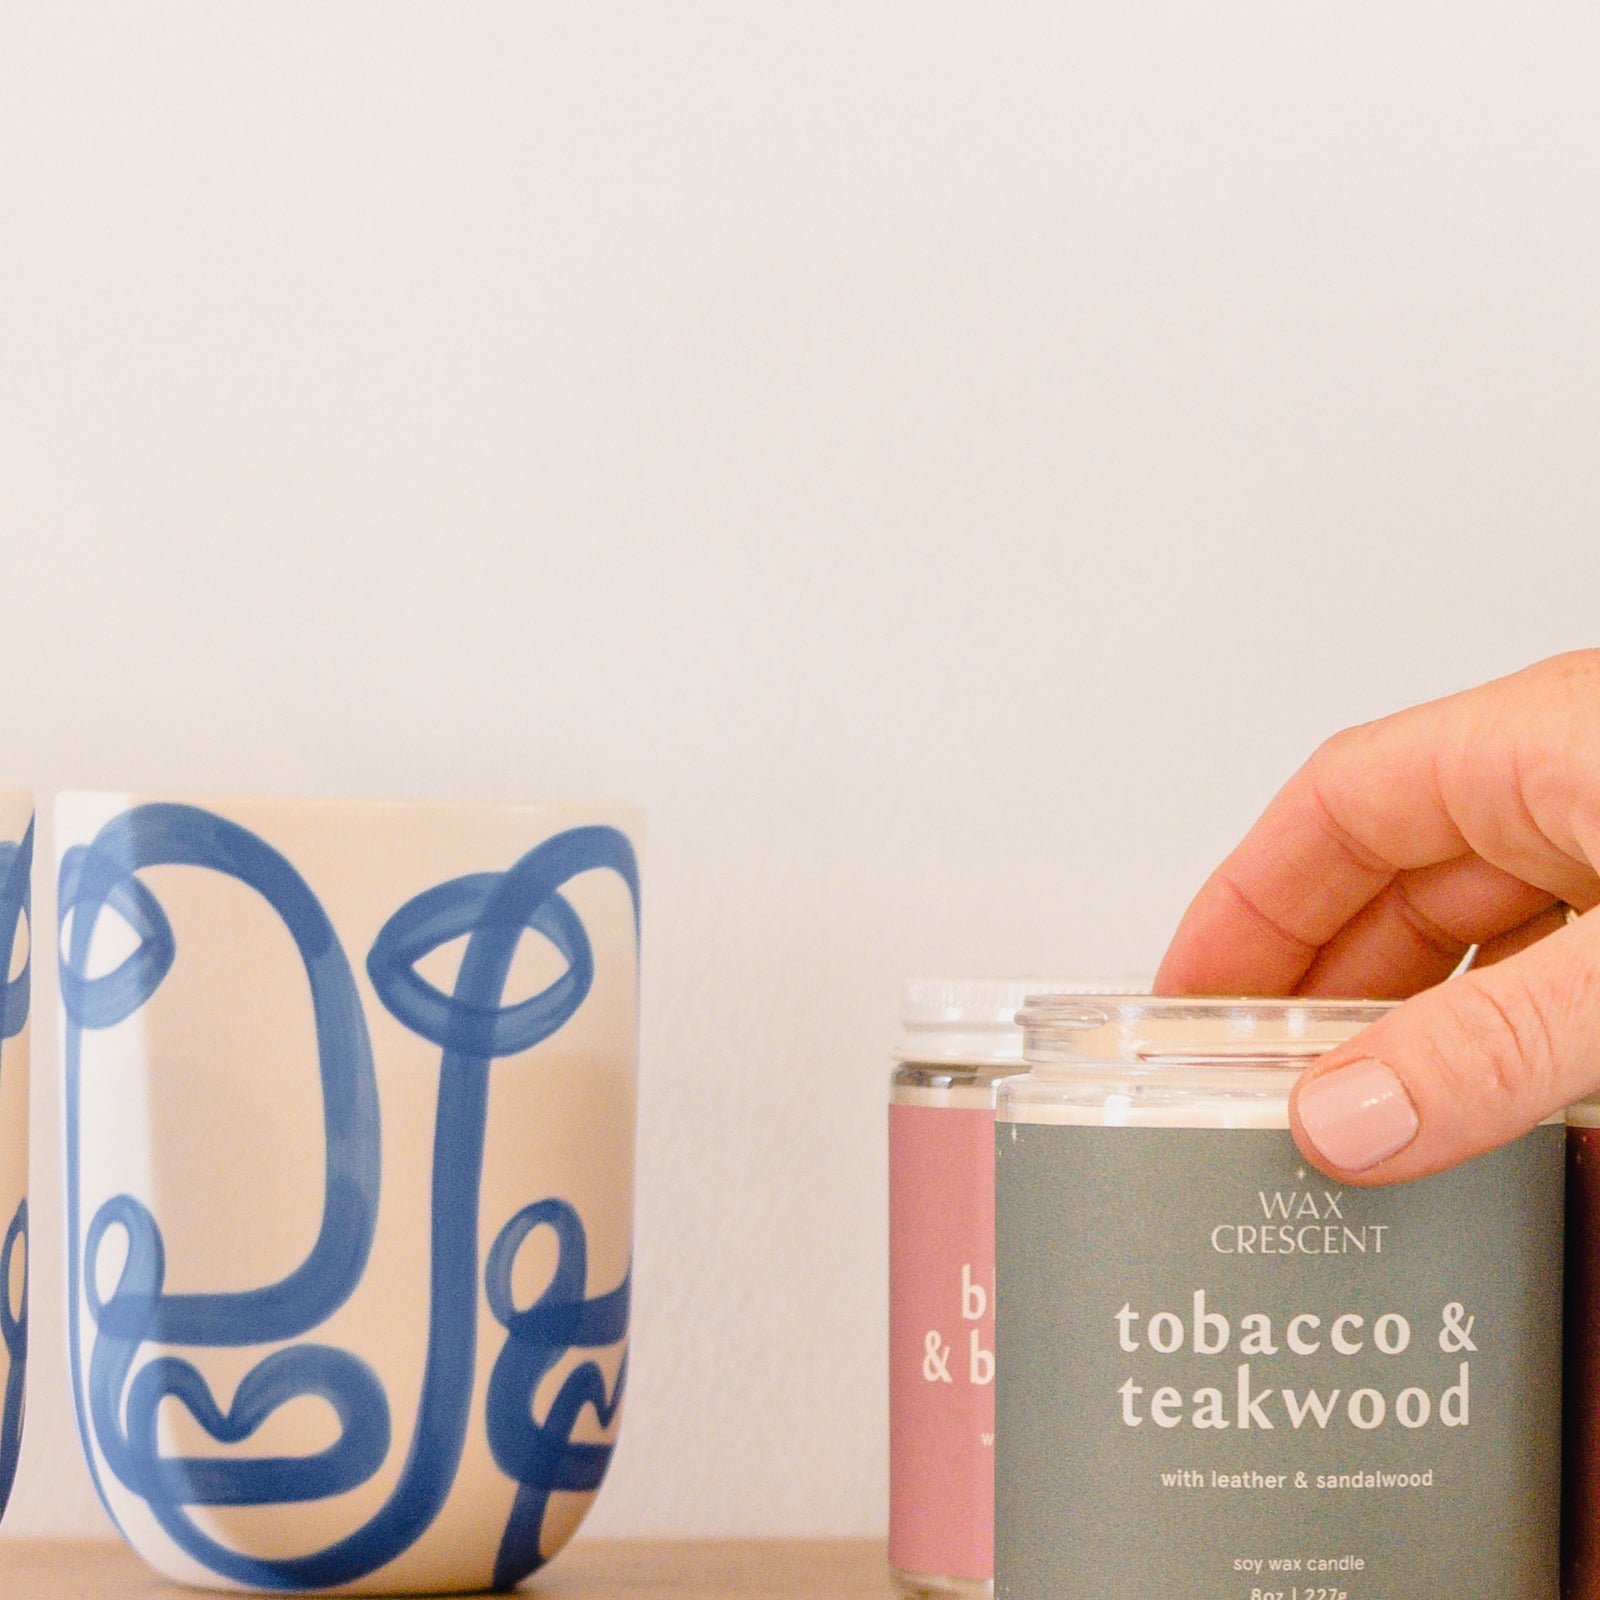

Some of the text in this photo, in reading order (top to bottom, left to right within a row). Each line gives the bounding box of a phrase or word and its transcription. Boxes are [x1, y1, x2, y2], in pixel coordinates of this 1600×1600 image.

[1258, 1191, 1343, 1220] WAX
[1210, 1224, 1388, 1254] CRESCENT
[1114, 1289, 1477, 1355] tobacco &
[922, 1330, 953, 1383] &
[1117, 1361, 1469, 1429] teakwood
[1161, 1469, 1433, 1489] with leather & sandalwood
[1233, 1555, 1365, 1575] soy wax candle
